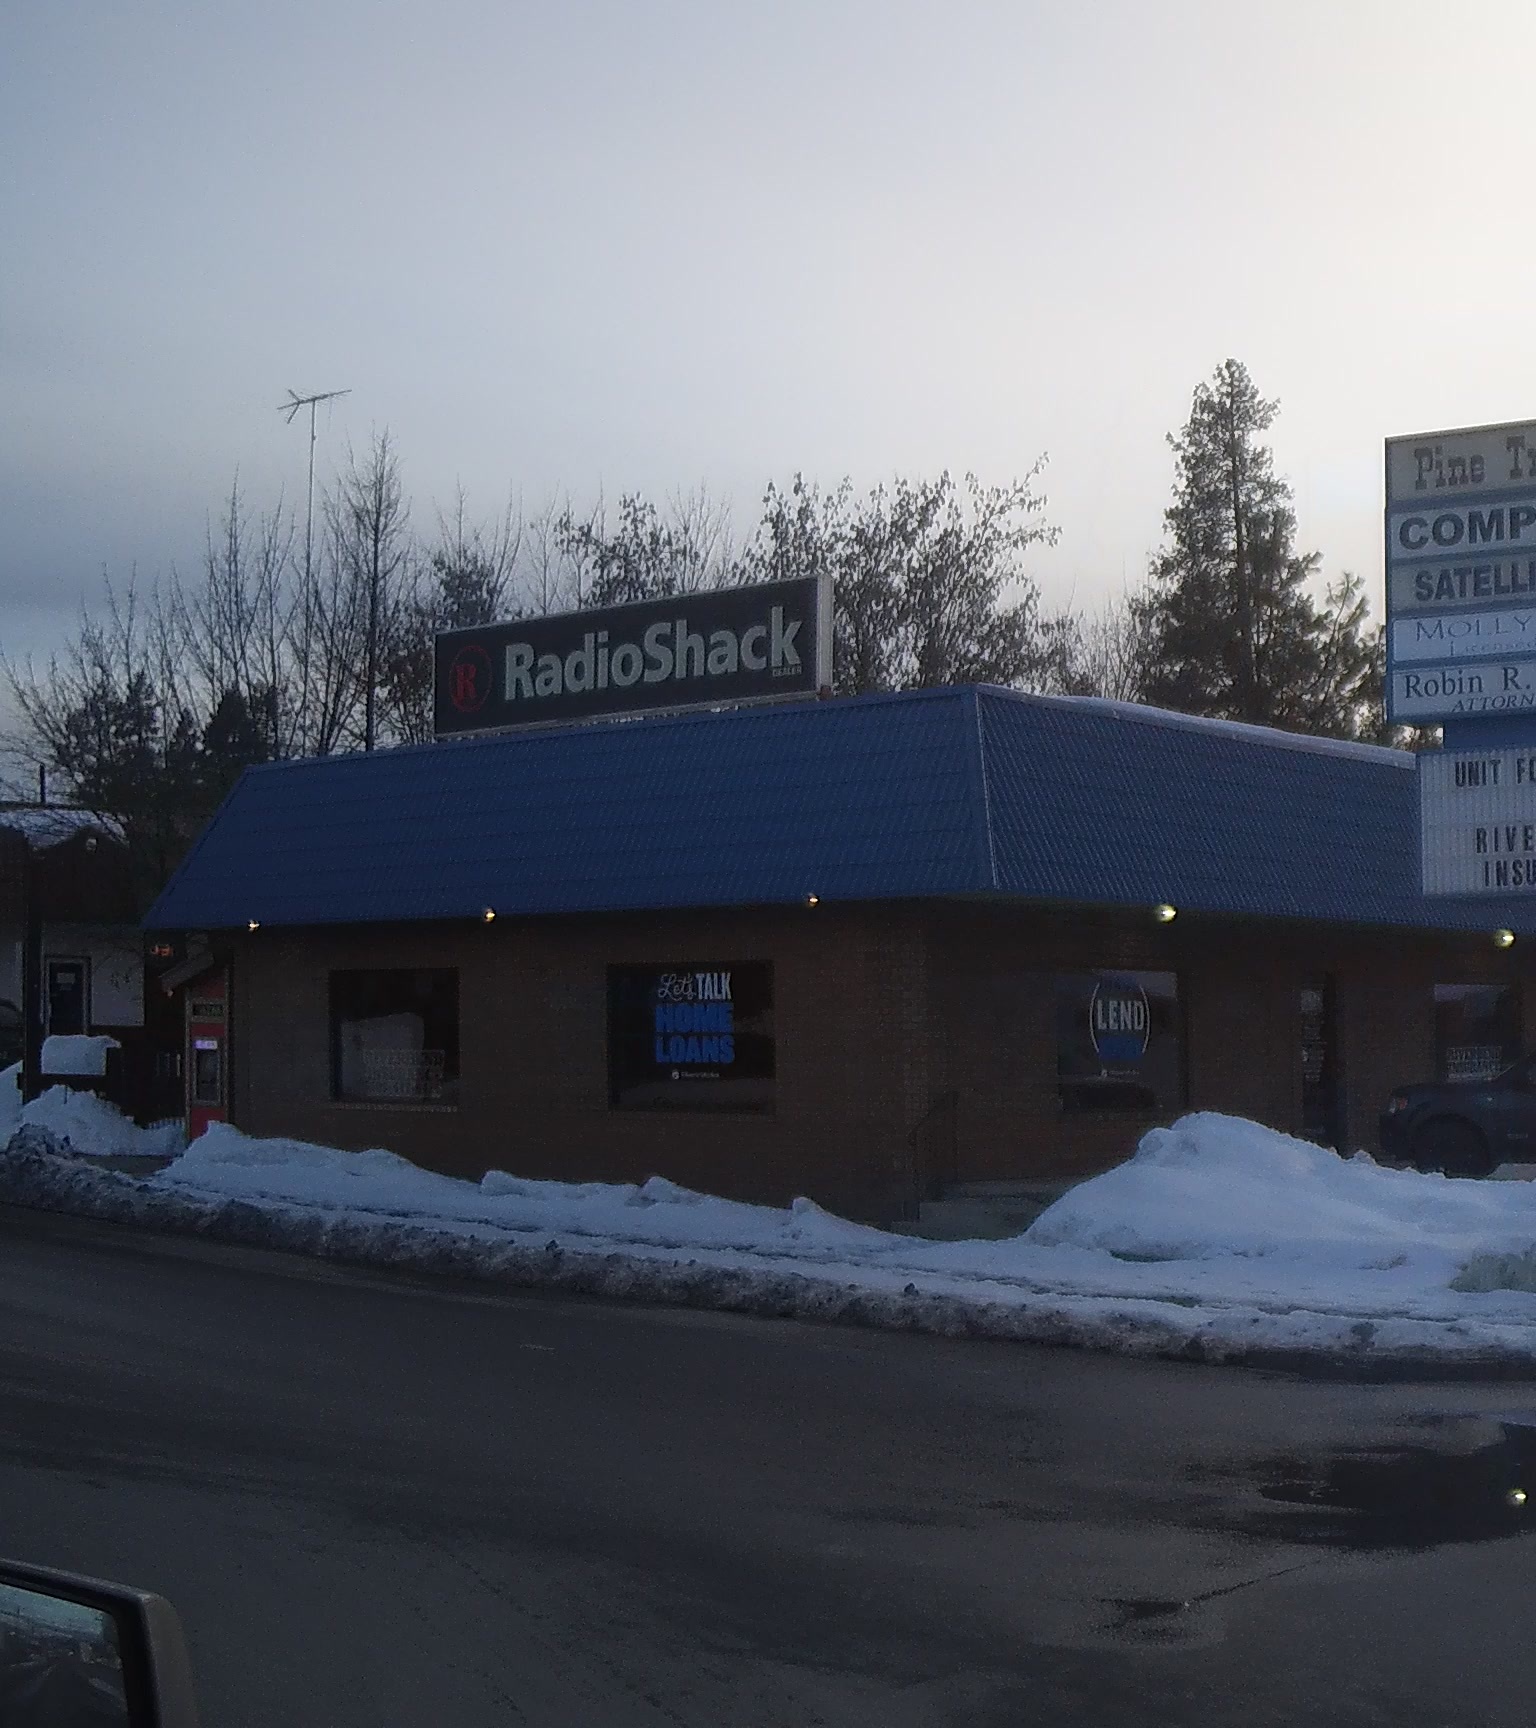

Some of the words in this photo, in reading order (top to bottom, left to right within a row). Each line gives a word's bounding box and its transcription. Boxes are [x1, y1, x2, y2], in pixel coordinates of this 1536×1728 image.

[1413, 446, 1486, 490] Pine
[1416, 614, 1532, 642] MOLLY
[504, 605, 803, 702] RadioShack
[1404, 669, 1484, 699] Robin
[1502, 666, 1531, 691] R.
[1454, 759, 1502, 788] UNIT
[657, 972, 696, 1001] Let's
[695, 972, 732, 1000] TALK
[655, 1002, 734, 1033] HOME
[1096, 999, 1146, 1030] LEND
[655, 1034, 735, 1064] LOANS
